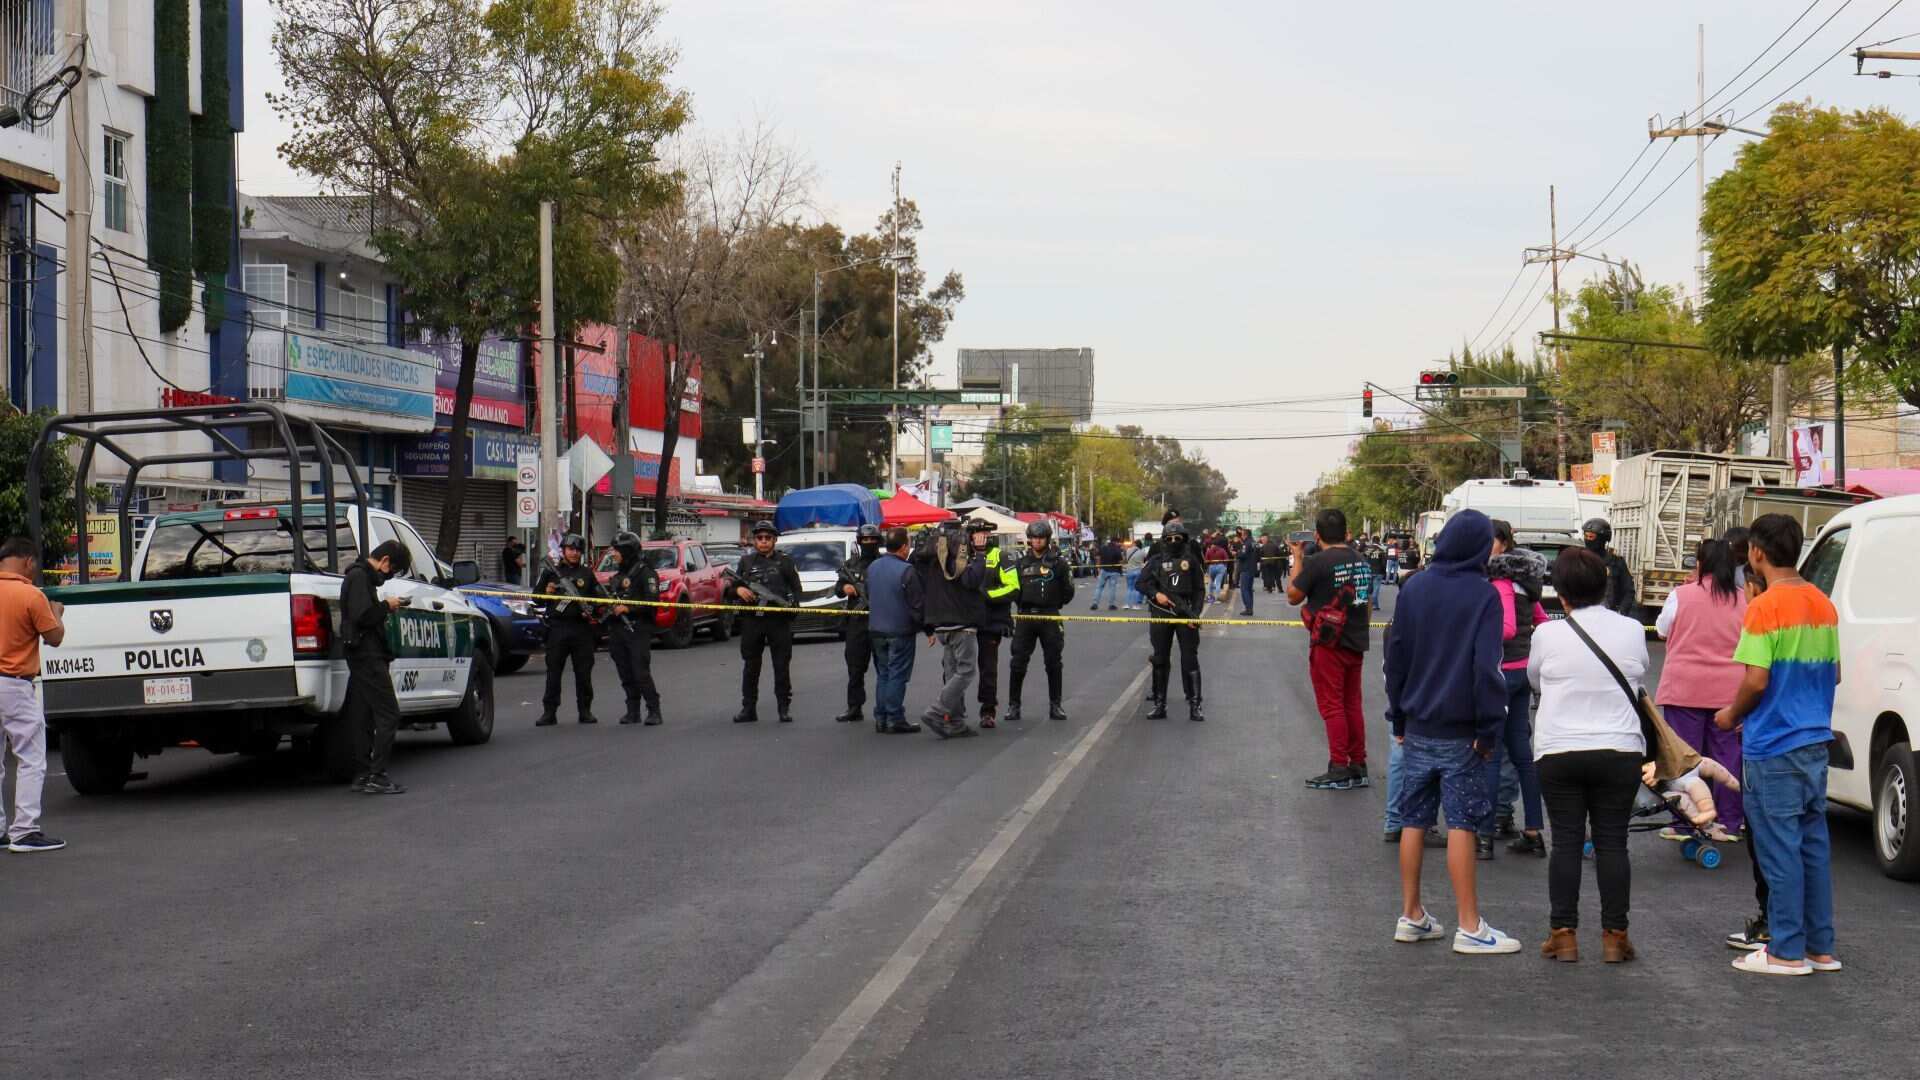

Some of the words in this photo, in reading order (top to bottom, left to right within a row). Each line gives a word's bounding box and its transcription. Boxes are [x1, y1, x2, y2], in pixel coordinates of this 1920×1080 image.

[306, 346, 381, 378] ESPECIALIDADES
[486, 441, 505, 462] CASA
[506, 444, 515, 463] DE
[399, 617, 440, 649] POLICIA
[46, 657, 95, 675] MX-014-E3
[124, 647, 206, 671] POLICIA
[401, 669, 419, 692] SSC
